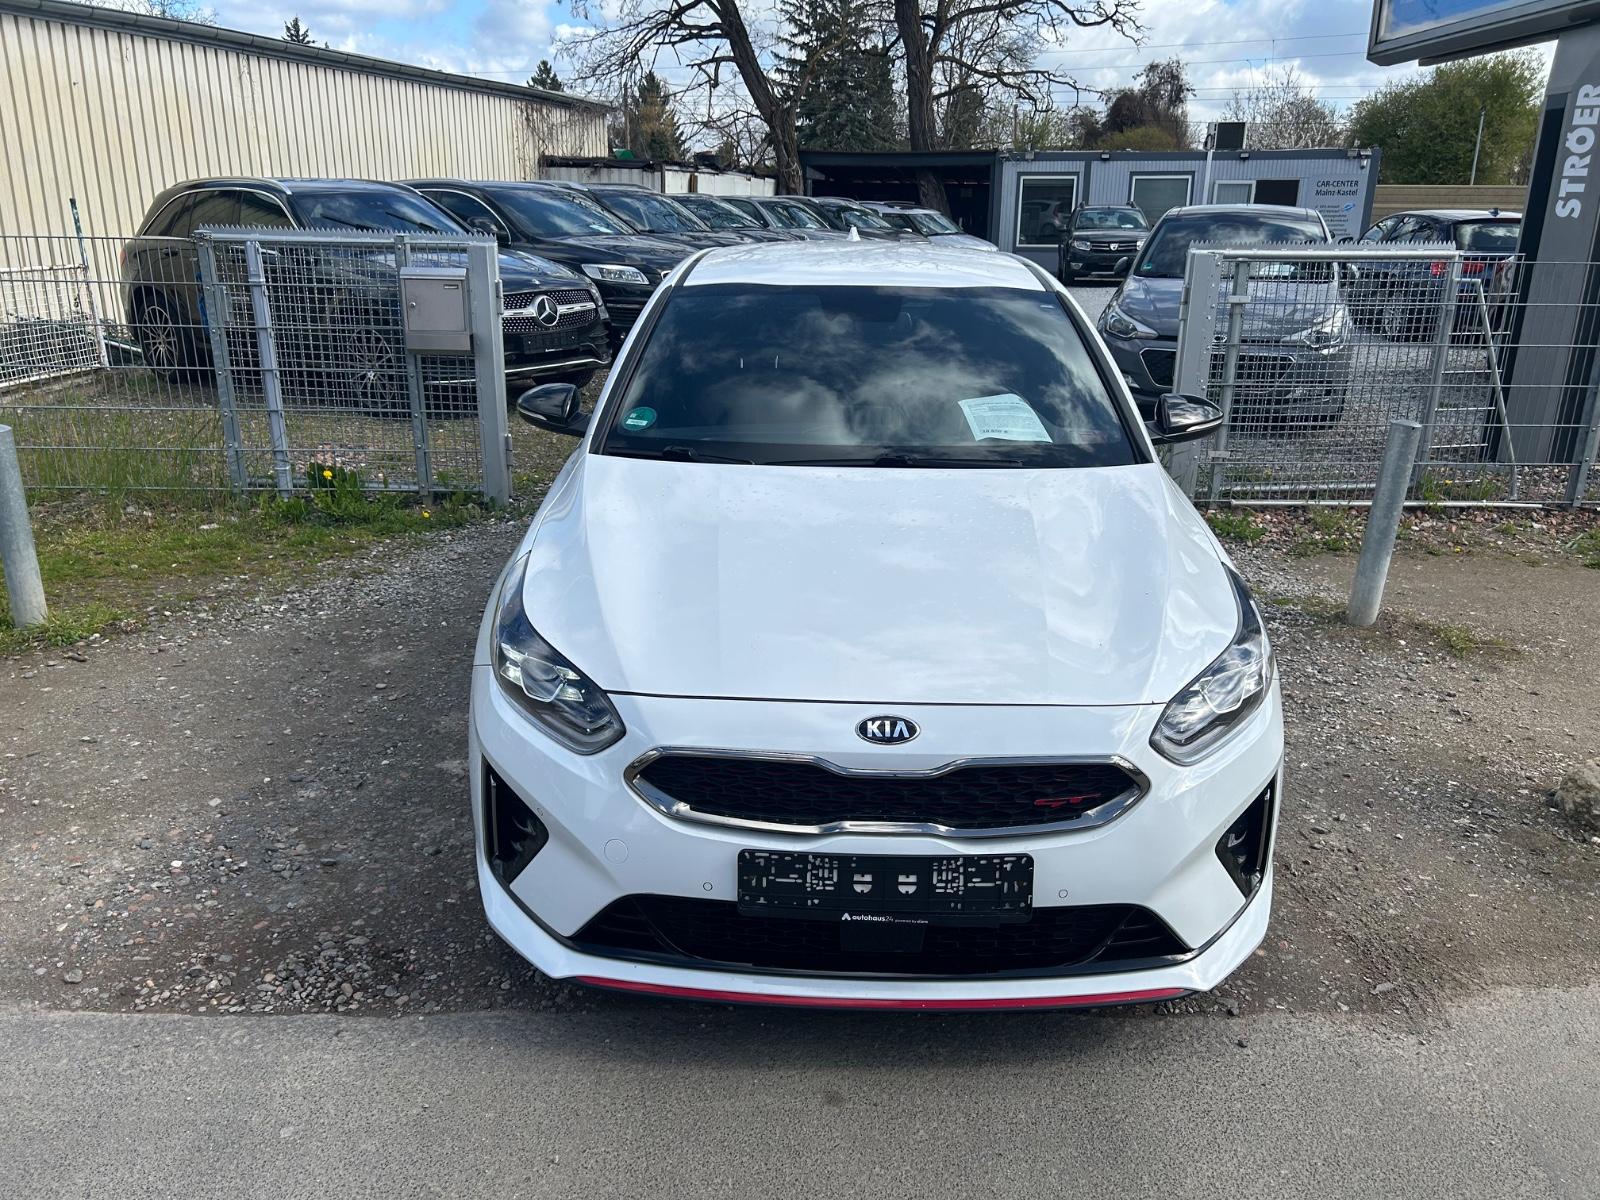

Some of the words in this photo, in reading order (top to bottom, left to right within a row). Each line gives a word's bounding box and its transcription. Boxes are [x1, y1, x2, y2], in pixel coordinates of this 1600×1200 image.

[1555, 84, 1600, 219] STRÖER
[1316, 180, 1359, 188] CAR-CENTER
[866, 720, 910, 738] KIA
